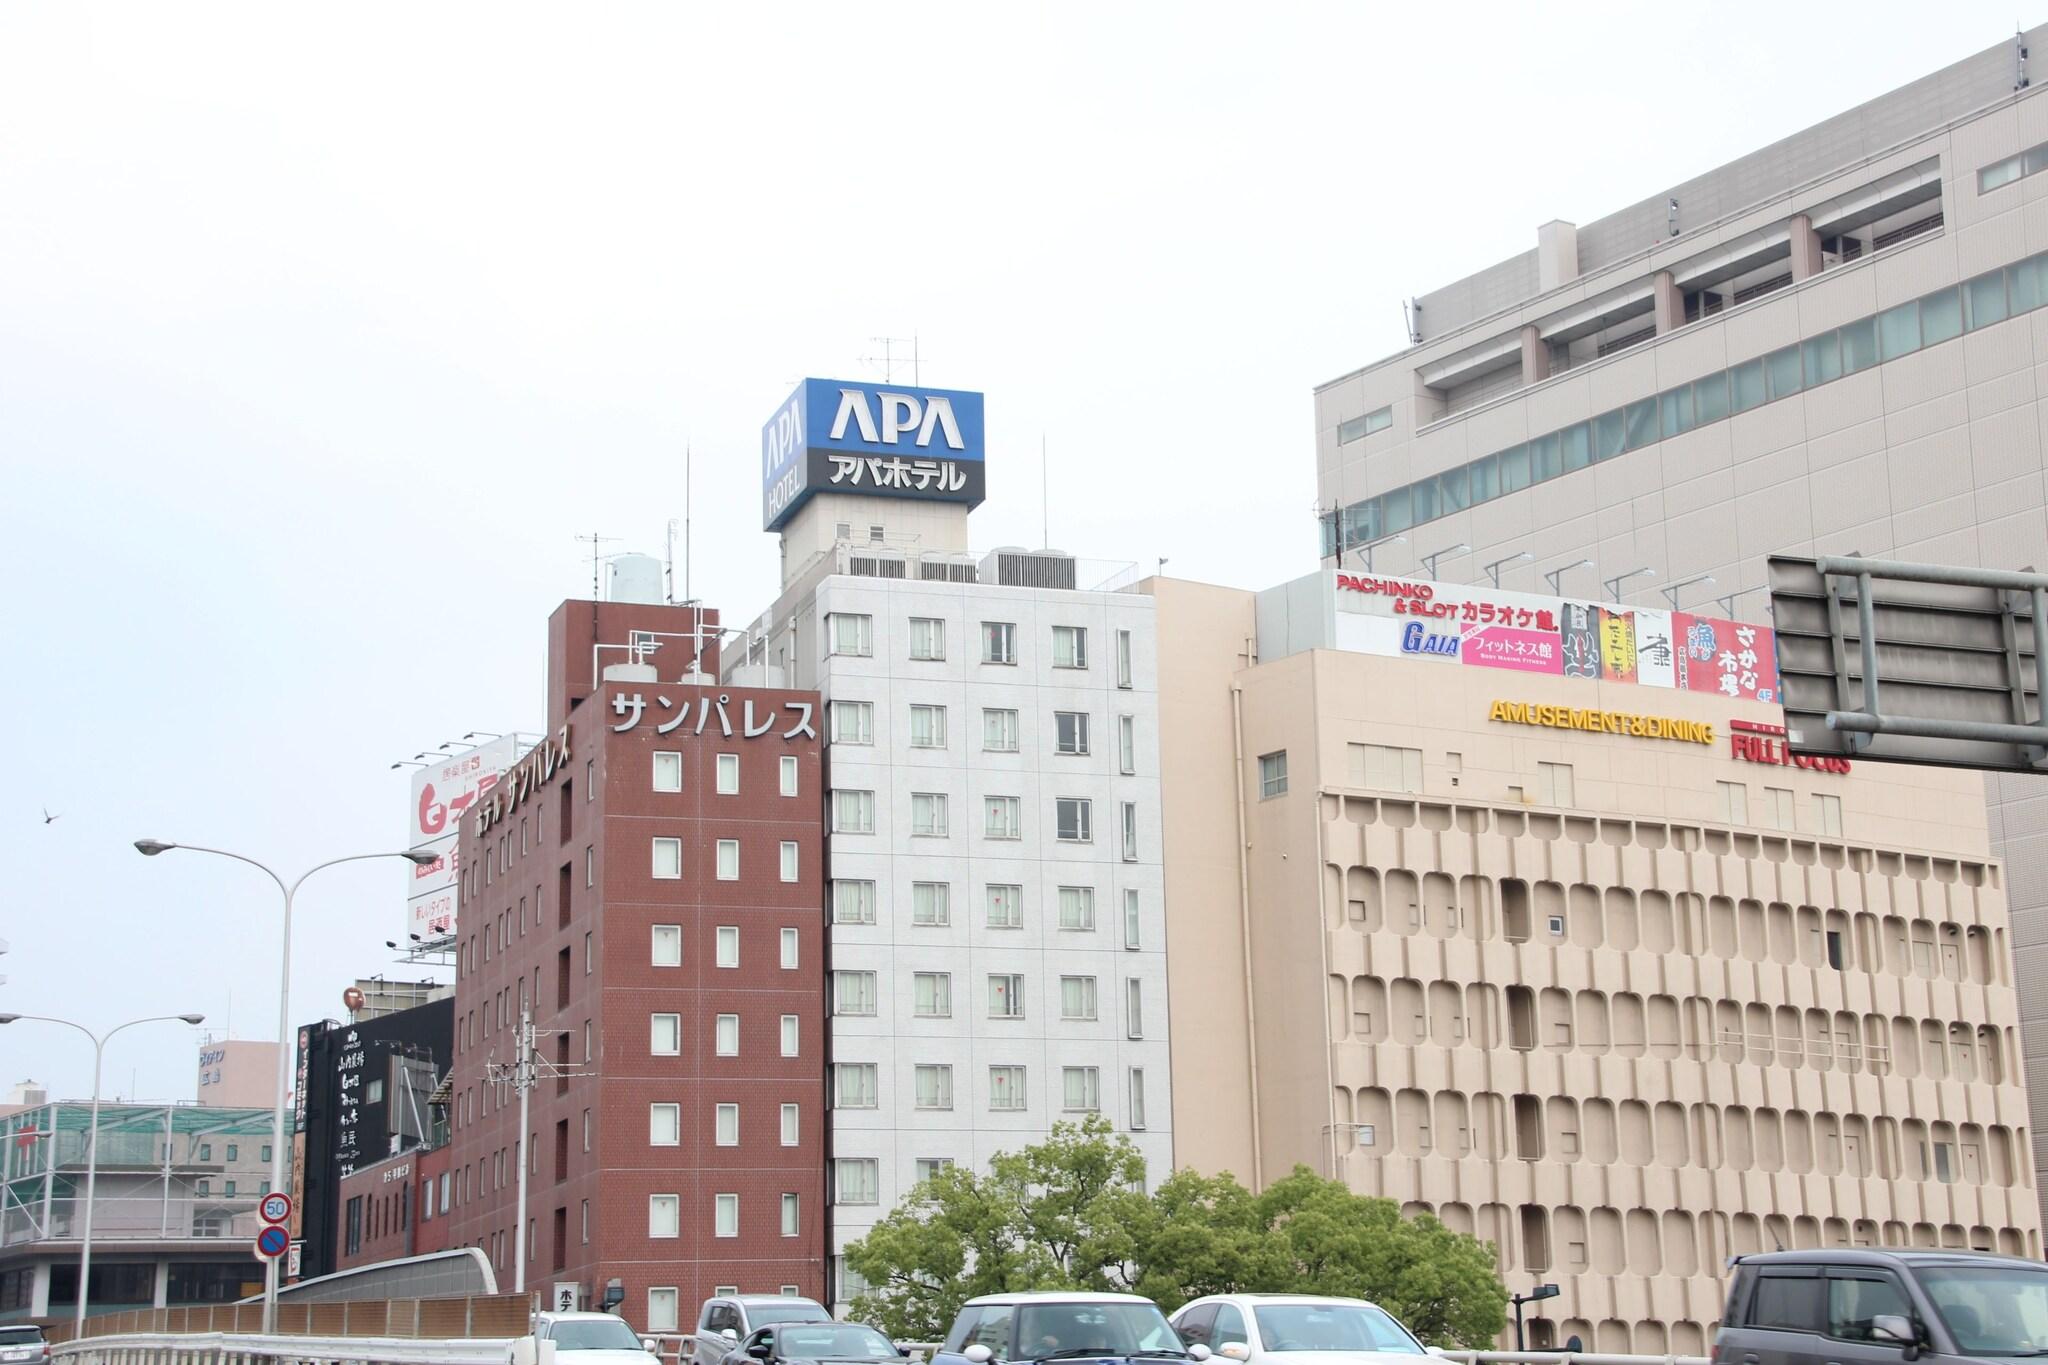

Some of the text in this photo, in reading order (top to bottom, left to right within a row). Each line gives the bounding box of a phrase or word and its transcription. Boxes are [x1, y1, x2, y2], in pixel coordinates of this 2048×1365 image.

[766, 398, 801, 479] APA
[829, 388, 965, 450] APA
[768, 465, 801, 519] HOTEL
[828, 455, 967, 492] アパホテル
[1336, 574, 1434, 600] PACHINKO
[1393, 598, 1459, 620] & SLOT
[1473, 636, 1553, 659] フィットネス館
[1735, 626, 1758, 691] さかな
[1717, 650, 1740, 697] 市場
[1757, 688, 1773, 703] 4F
[612, 693, 817, 740] サンパレス
[1489, 700, 1715, 745] AMUSEMENT&DINING
[1731, 734, 1780, 765] FULL
[475, 724, 571, 838] ホテル サンパレス
[266, 1201, 285, 1216] 50
